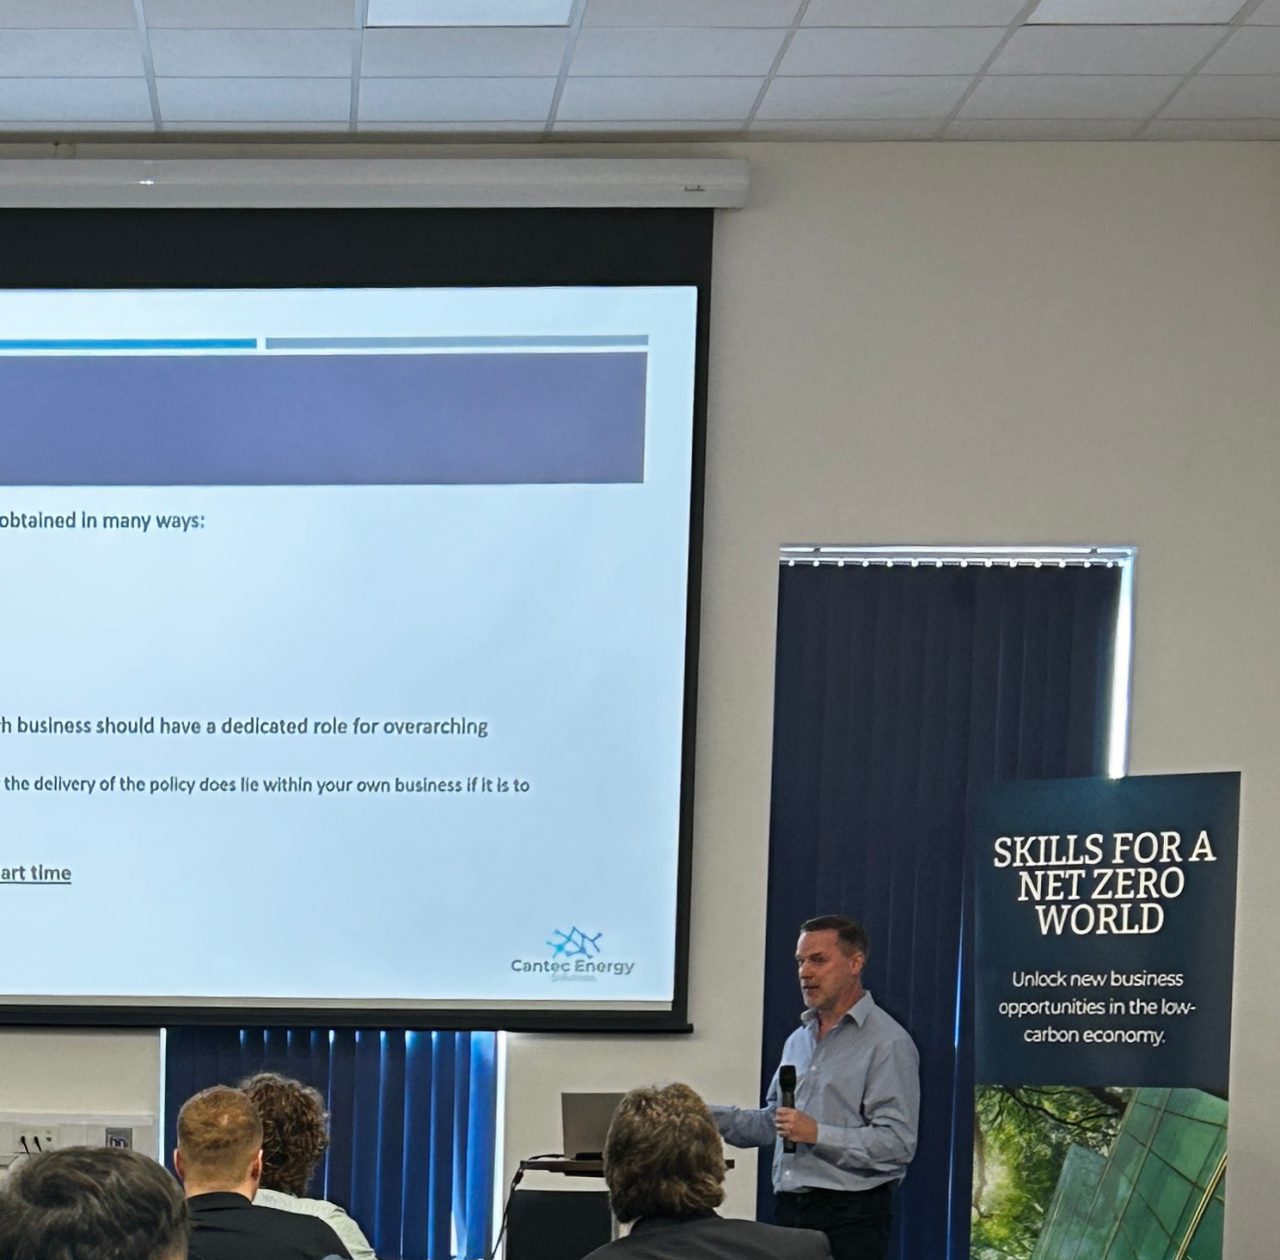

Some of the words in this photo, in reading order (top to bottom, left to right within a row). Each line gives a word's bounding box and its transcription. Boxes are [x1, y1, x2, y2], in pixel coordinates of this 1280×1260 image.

[81, 510, 98, 529] in
[102, 514, 152, 533] many
[155, 515, 205, 533] ways:
[17, 715, 92, 734] business
[96, 716, 155, 735] should
[160, 716, 202, 735] have
[206, 721, 216, 735] a
[221, 716, 309, 735] dedicated
[313, 716, 348, 735] role
[352, 716, 380, 735] for
[383, 716, 489, 739] overarching
[4, 775, 30, 791] the
[33, 775, 96, 795] delivery
[99, 775, 116, 792] of
[119, 775, 146, 792] the
[149, 775, 196, 795] policy
[199, 776, 237, 792] does
[240, 776, 259, 793] lie
[262, 776, 313, 793] within
[316, 780, 353, 796] your
[356, 780, 391, 793] own
[395, 777, 463, 793] business
[466, 776, 479, 793] if
[481, 776, 493, 793] it
[496, 777, 510, 793] is
[513, 778, 530, 793] to
[993, 833, 1104, 868] SKILLS
[1111, 831, 1183, 864] FOR
[1188, 830, 1217, 862] A
[31, 865, 71, 880] time
[1017, 870, 1086, 902] NET
[1091, 866, 1185, 900] ZERO
[1035, 903, 1165, 936] WORLD
[510, 959, 571, 973] Cantec
[574, 959, 635, 976] Energy
[1012, 971, 1068, 987] Unlock
[1070, 974, 1108, 987] new
[1109, 970, 1184, 987] business
[998, 998, 1106, 1018] opportunities
[1109, 998, 1126, 1015] in
[1129, 998, 1158, 1015] the
[1161, 998, 1197, 1015] low-
[1023, 1026, 1080, 1043] carbon
[1082, 1028, 1166, 1047] economy.
